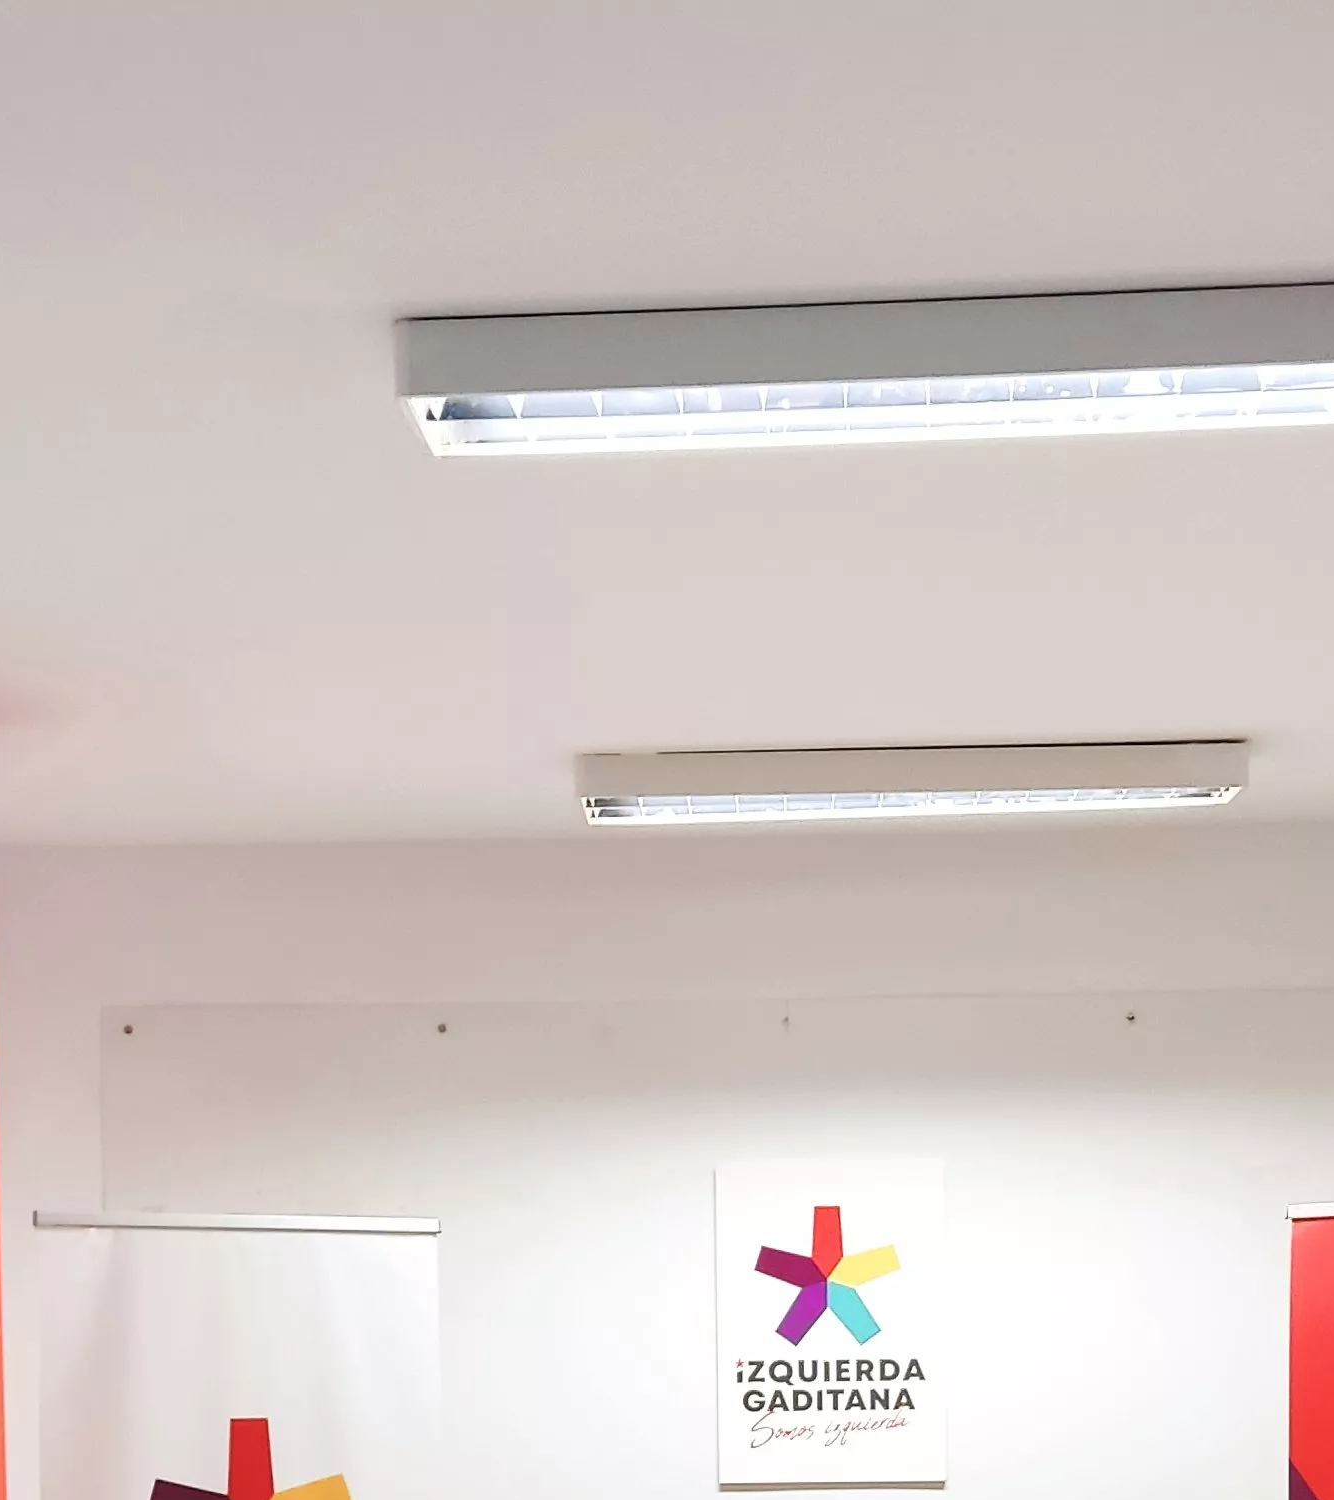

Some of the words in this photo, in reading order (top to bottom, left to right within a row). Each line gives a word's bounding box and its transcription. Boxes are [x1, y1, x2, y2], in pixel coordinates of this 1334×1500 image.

[742, 1387, 916, 1412] GADITANA
[750, 1410, 815, 1449] Somos
[824, 1401, 911, 1447] izquierda
